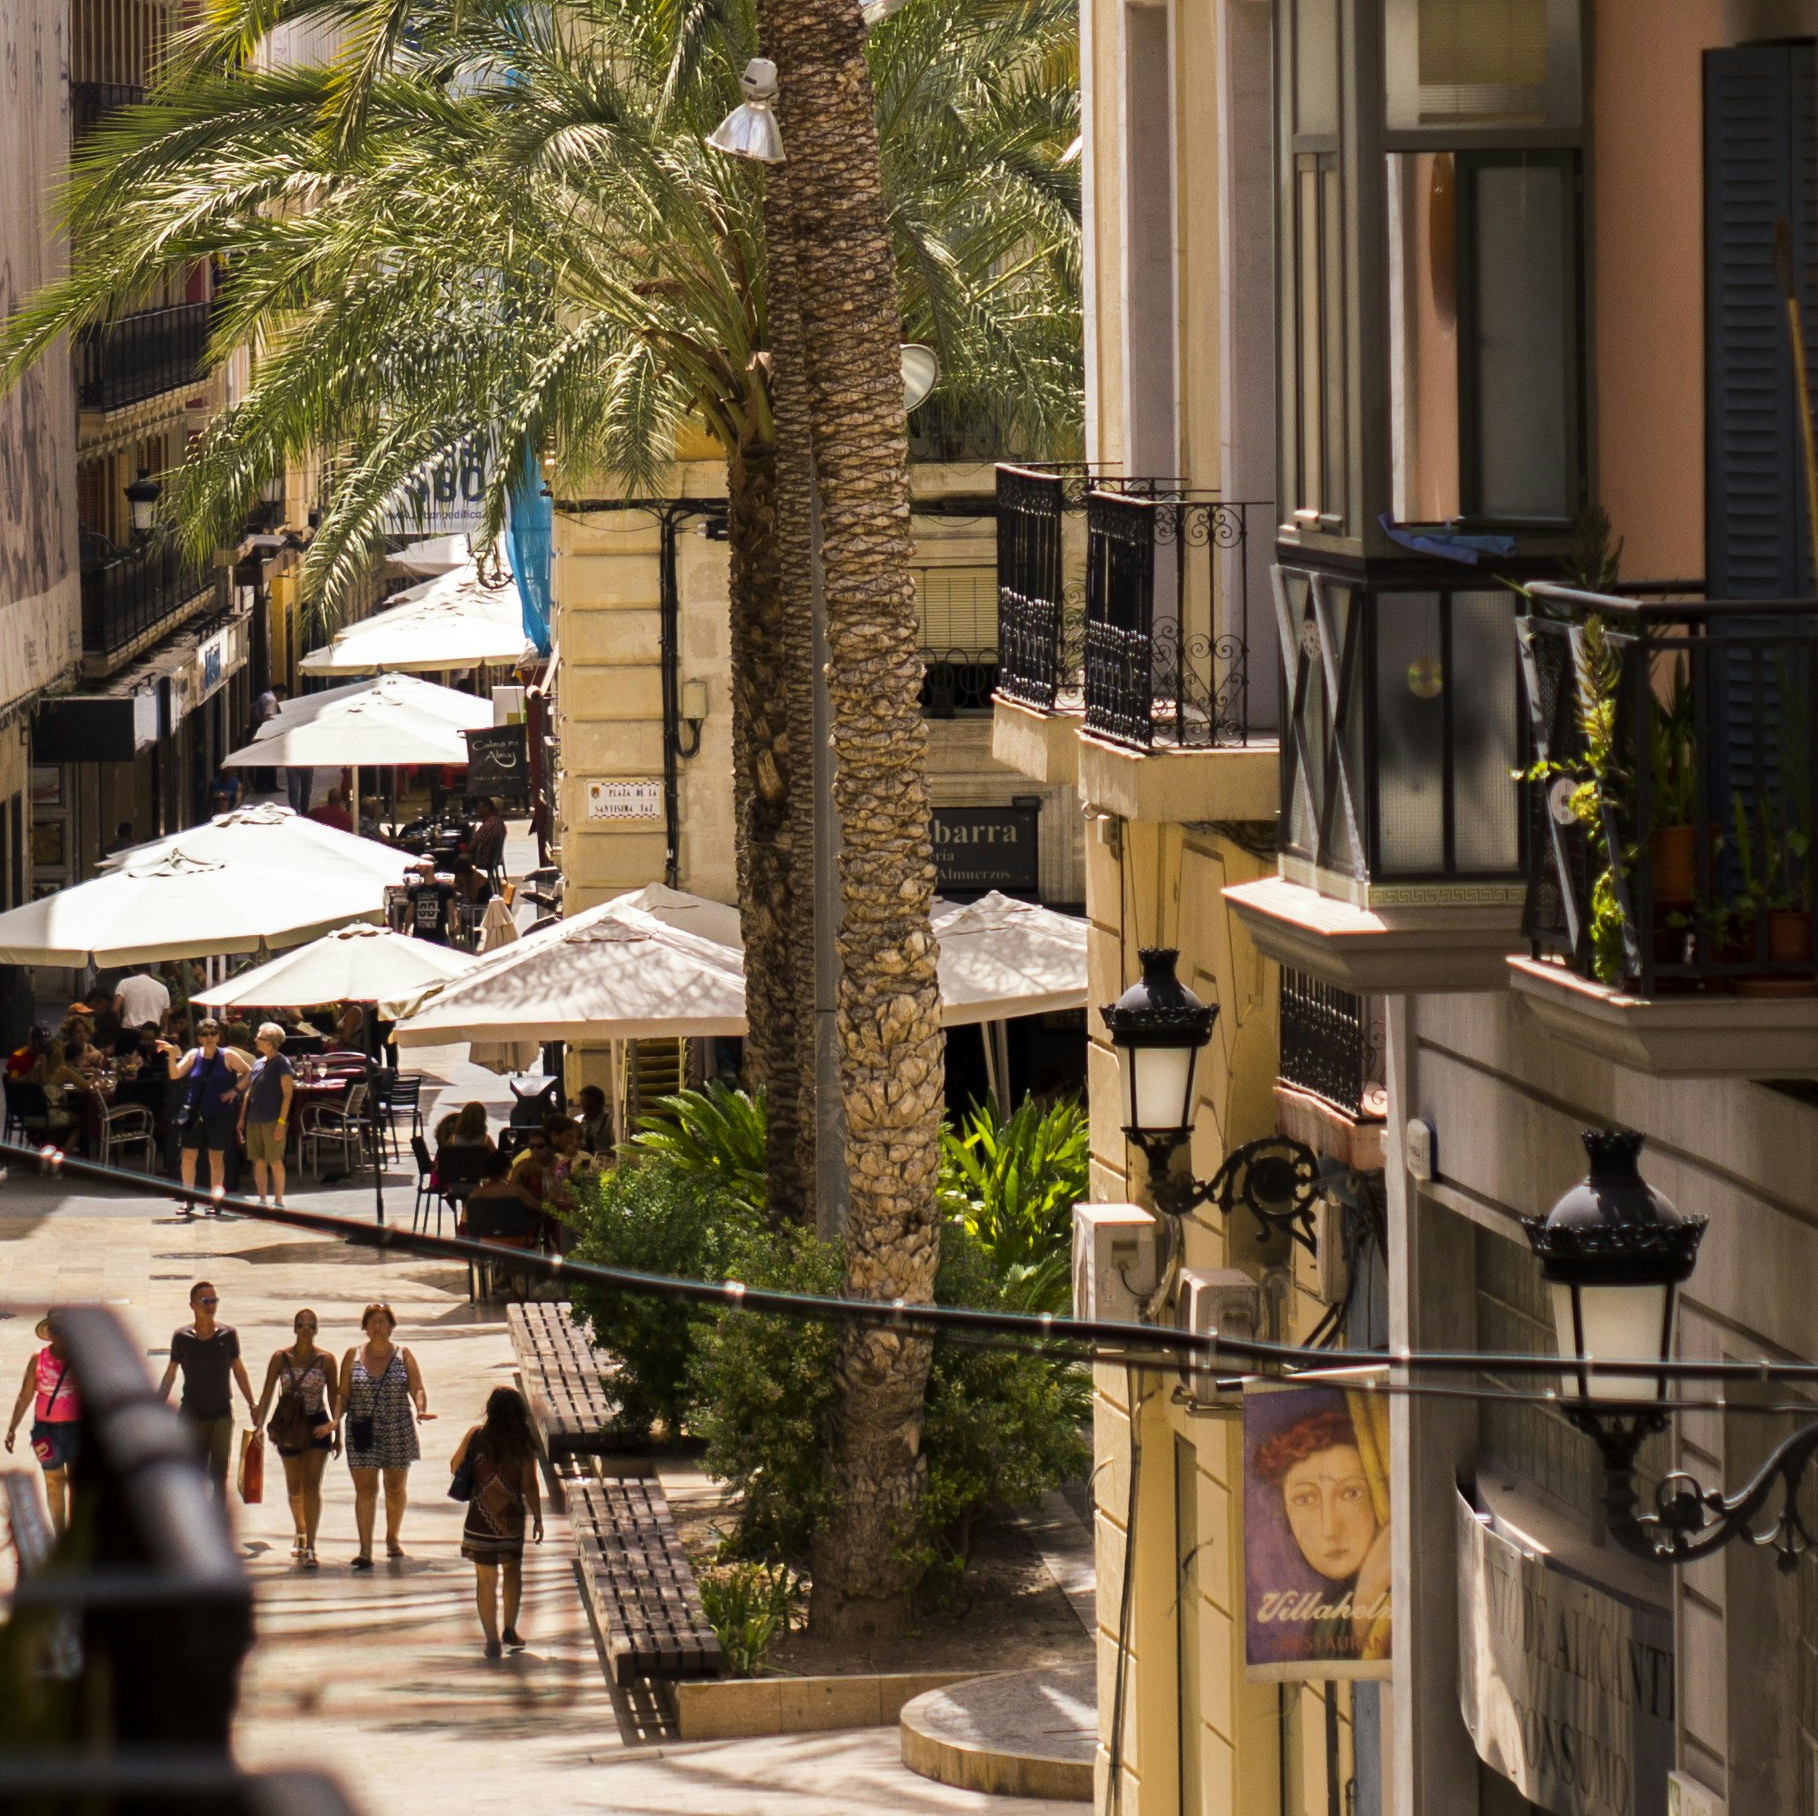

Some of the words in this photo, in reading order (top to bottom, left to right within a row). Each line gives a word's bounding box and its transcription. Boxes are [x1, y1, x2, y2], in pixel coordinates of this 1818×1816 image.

[609, 788, 631, 798] PLAZA
[636, 788, 644, 798] DE
[648, 788, 657, 797] LA
[640, 804, 653, 812] FAZ
[939, 868, 1011, 881] Almuerzos
